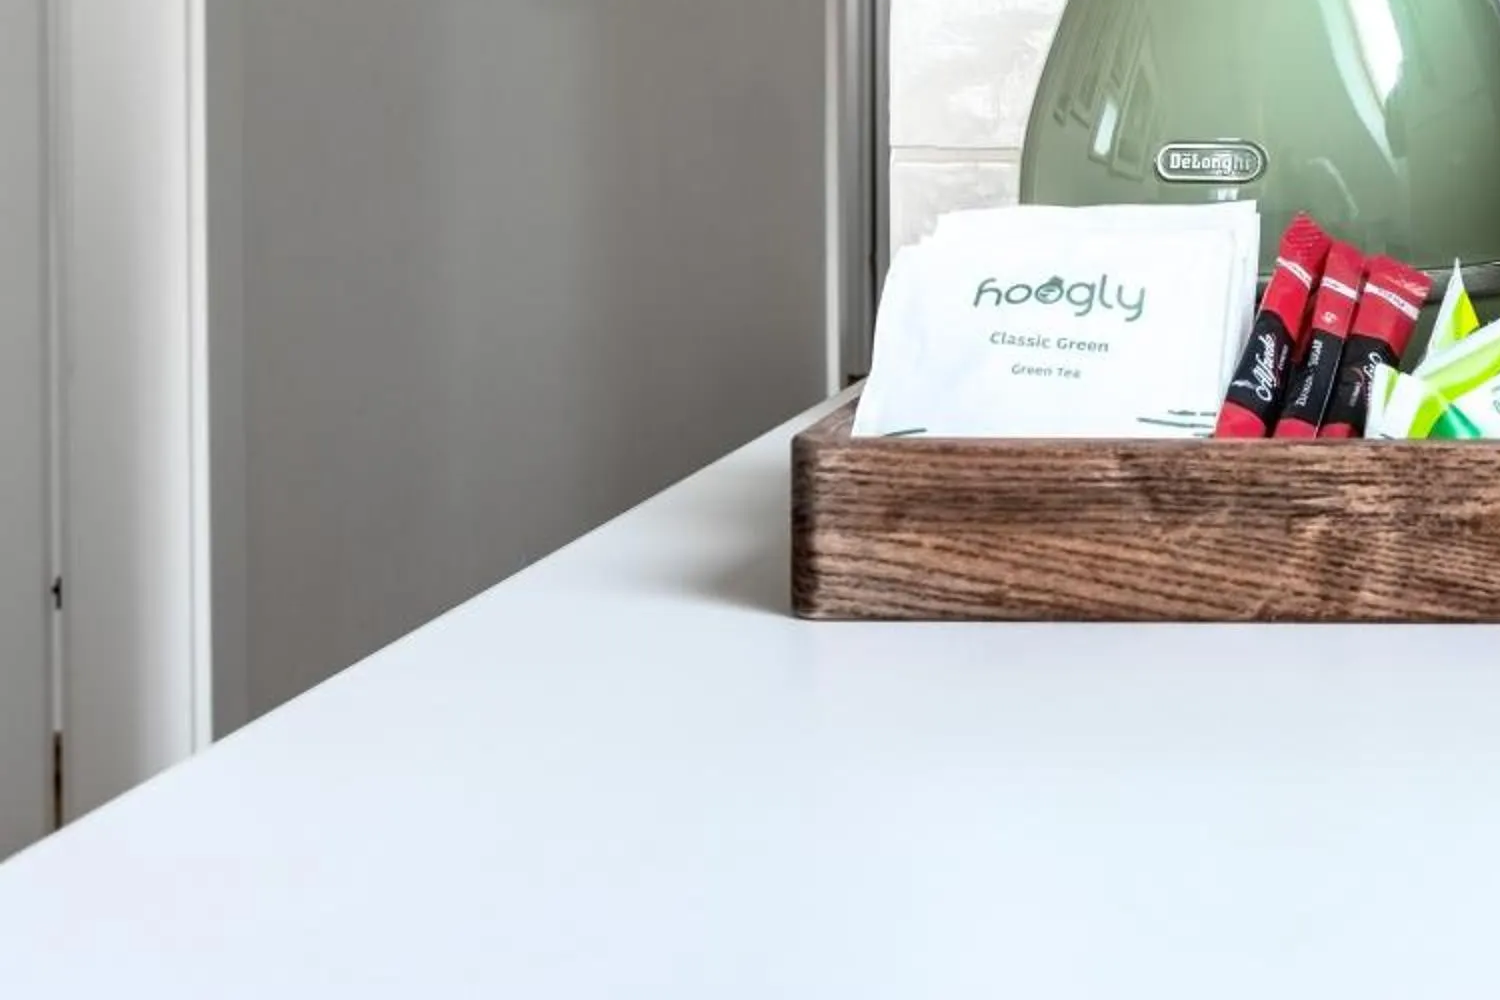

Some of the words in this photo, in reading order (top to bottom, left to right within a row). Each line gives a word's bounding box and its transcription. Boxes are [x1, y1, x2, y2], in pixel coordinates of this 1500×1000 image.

[973, 274, 1146, 322] hoogly
[990, 331, 1051, 349] Classic
[1056, 338, 1109, 352] Green
[1011, 363, 1053, 377] Green
[1057, 367, 1081, 379] Tea
